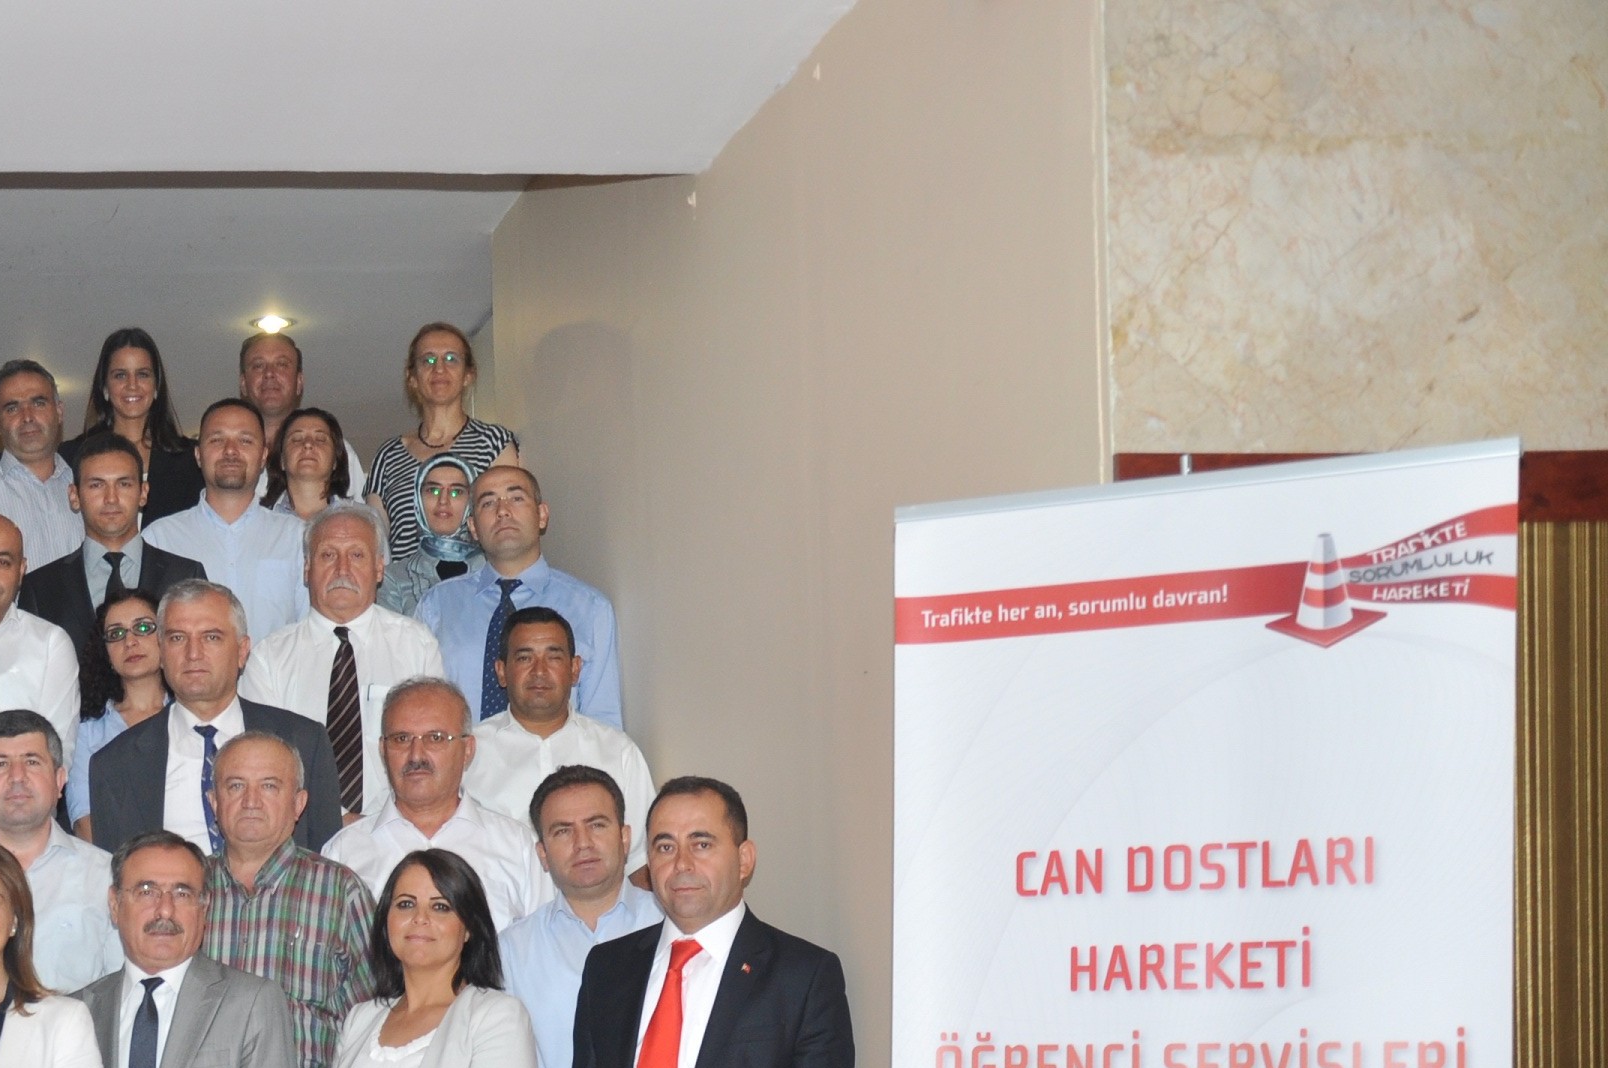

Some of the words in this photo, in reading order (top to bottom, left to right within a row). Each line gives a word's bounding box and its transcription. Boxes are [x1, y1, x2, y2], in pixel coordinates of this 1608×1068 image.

[1366, 522, 1467, 565] TRAFİKTE
[1349, 551, 1494, 584] SORUMLULUK
[1372, 578, 1470, 600] HAREKETİ
[921, 608, 992, 629] Trafikte
[998, 605, 1029, 622] her
[1034, 605, 1063, 621] an,
[1068, 593, 1147, 615] sorumlu
[1152, 584, 1228, 607] davran!
[1015, 848, 1103, 897] CAN
[1127, 836, 1374, 893] DOSTLARI
[1070, 926, 1311, 991] HAREKETİ
